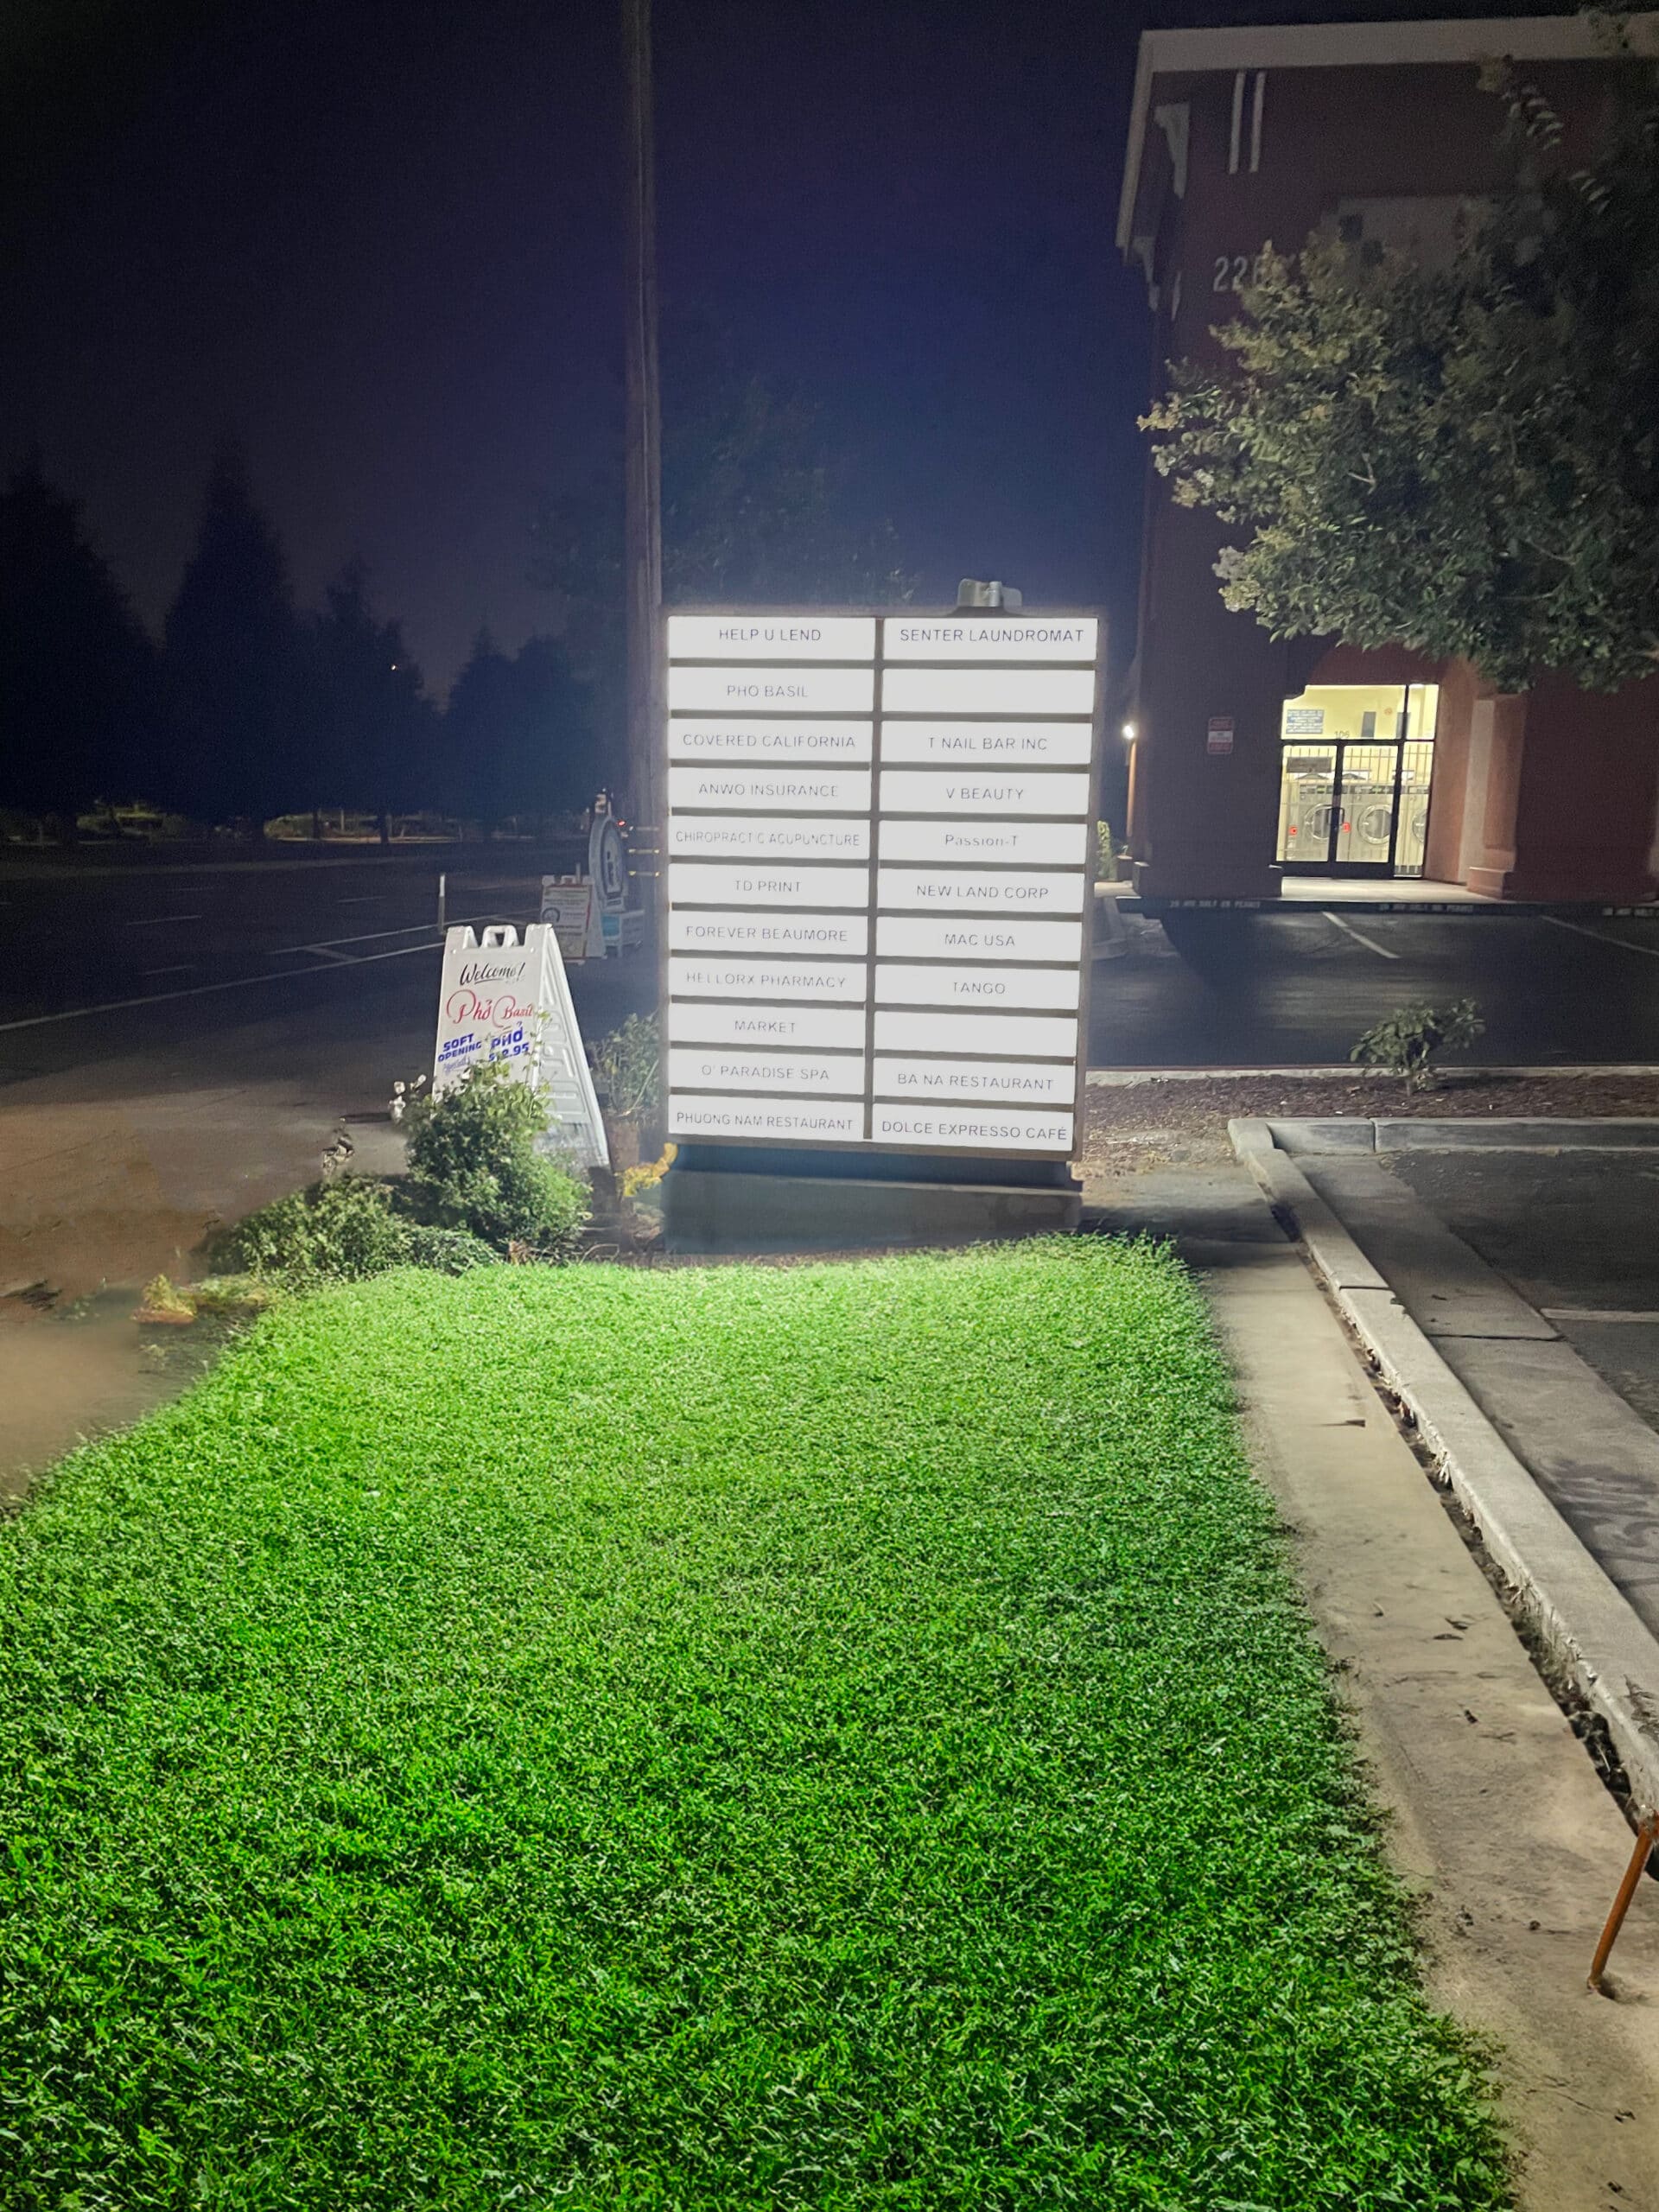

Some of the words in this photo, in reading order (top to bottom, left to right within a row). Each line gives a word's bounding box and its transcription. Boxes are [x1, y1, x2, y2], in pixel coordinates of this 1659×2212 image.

[720, 629, 759, 640] HELP
[765, 629, 773, 640] U
[781, 629, 821, 640] LEND
[900, 630, 963, 641] SENTER
[969, 630, 1084, 641] LAUNDROMAT
[728, 685, 759, 698] PHO
[765, 686, 807, 697] BASIL
[683, 734, 756, 746] COVERED
[763, 736, 855, 747] CALIFORNIA
[928, 737, 936, 748] T
[942, 738, 976, 749] NAIL
[983, 738, 1015, 749] BAR
[1022, 739, 1046, 750] INC
[699, 784, 745, 795] ANWO
[752, 785, 838, 797] INSURANCE
[946, 788, 955, 798] V
[961, 788, 1023, 799] BEAUTY
[676, 831, 765, 844] CHIROPRACTC
[768, 833, 860, 846] ACUPUNCTURE
[734, 880, 752, 891] TD
[759, 880, 800, 892] PRINT
[917, 886, 951, 897] NEW
[957, 887, 999, 898] LAND
[1005, 887, 1048, 899] CORP
[687, 926, 755, 938] FOREVER
[762, 929, 847, 941] BEAUMORE
[945, 934, 977, 945] MAC
[984, 935, 1014, 946] USA
[460, 963, 525, 985] Welcome!
[761, 975, 845, 988] PHARMACY
[953, 982, 1005, 994] TANGO
[735, 1020, 795, 1033] MARKET
[442, 1033, 474, 1052] SOFT
[437, 1040, 482, 1063] OPENING
[721, 1066, 793, 1078] PARADISE
[801, 1069, 829, 1079] SPA
[899, 1074, 917, 1084] BA
[924, 1075, 943, 1084] NA
[950, 1076, 1052, 1090] RESTAURANT
[677, 1113, 730, 1125] PHUONG
[735, 1116, 762, 1125] NAM
[767, 1116, 853, 1129] RESTAURANT
[882, 1122, 931, 1135] DOLCE
[939, 1124, 1020, 1137] EXPRESSO
[1027, 1127, 1066, 1140] CAFÉ
